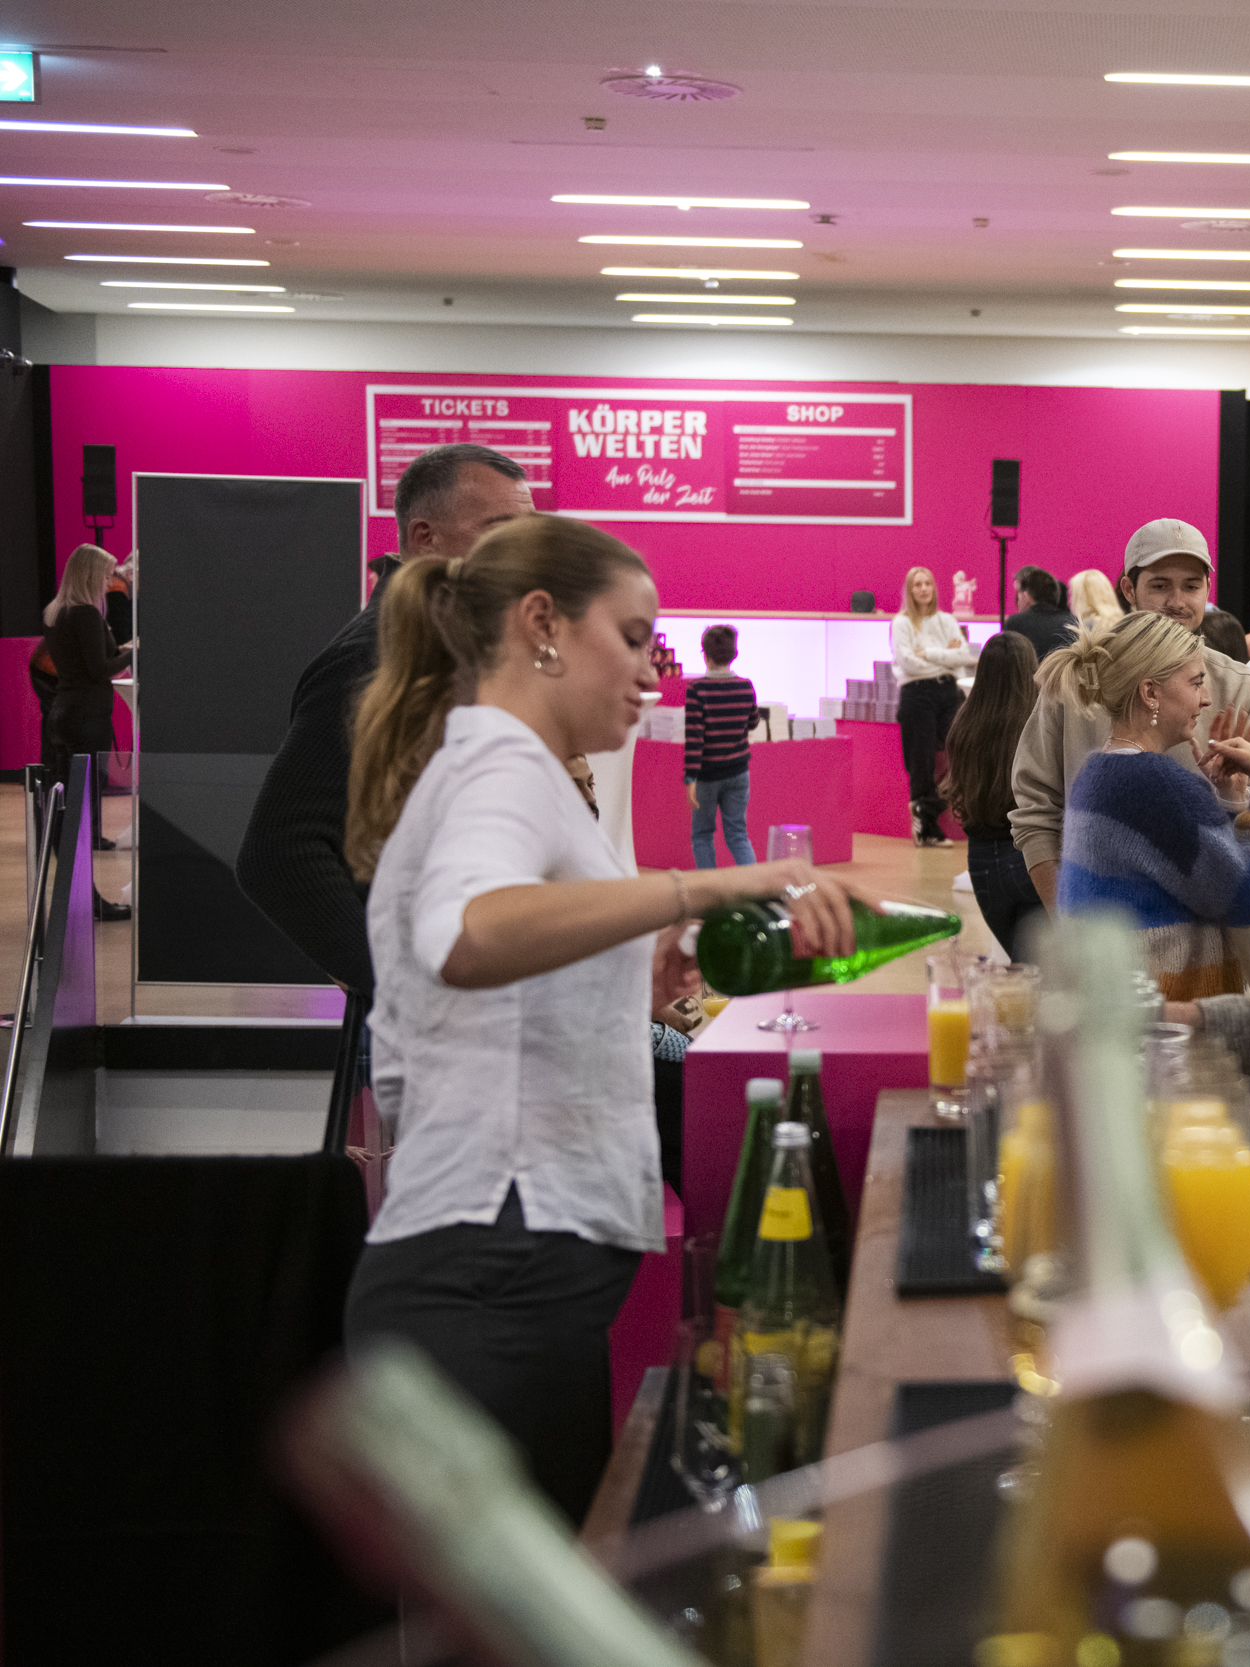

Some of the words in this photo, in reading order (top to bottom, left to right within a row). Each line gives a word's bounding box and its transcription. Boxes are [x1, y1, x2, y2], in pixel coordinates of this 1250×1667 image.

[421, 399, 509, 416] TICKETS
[568, 403, 707, 435] KÖRPER
[787, 405, 844, 422] SHOP
[573, 433, 703, 459] WELTEN
[605, 465, 633, 488] Am
[637, 464, 676, 489] Puls
[643, 486, 671, 504] der
[675, 485, 717, 506] Zeit
